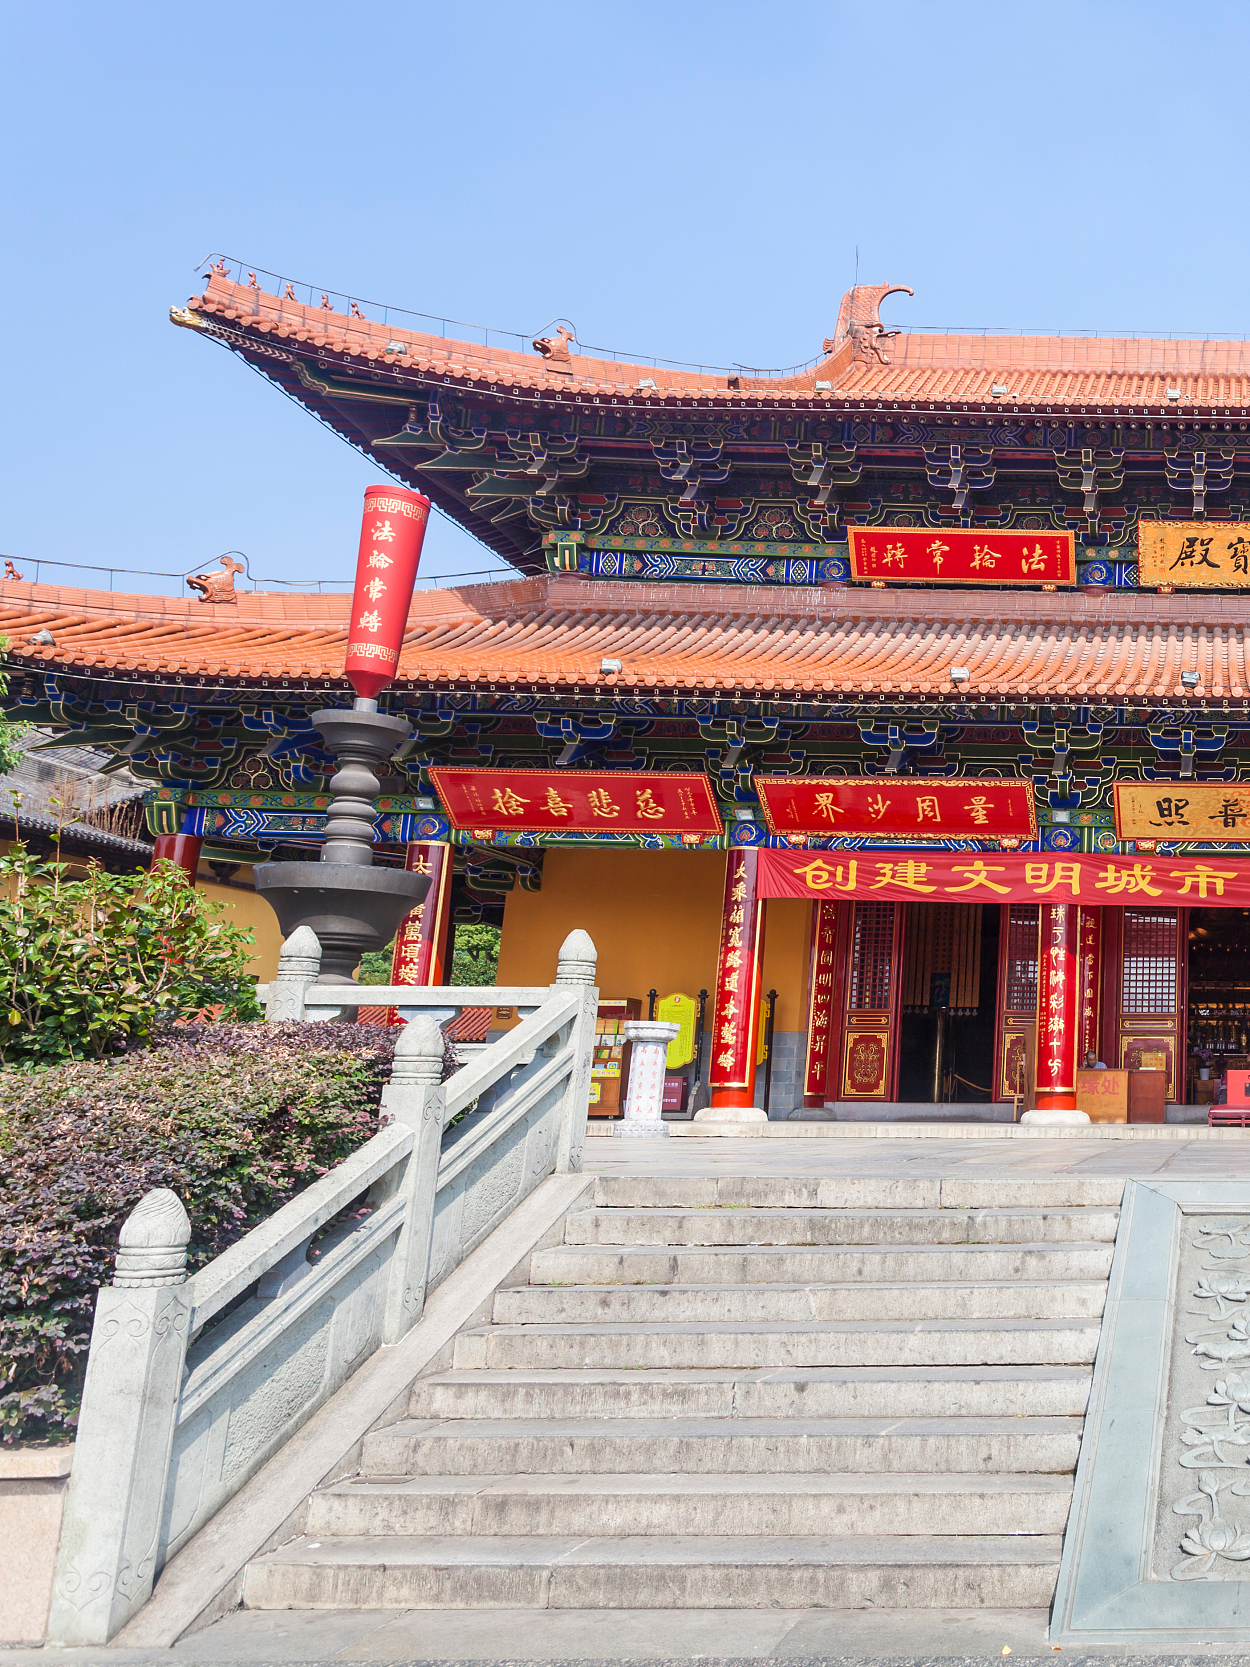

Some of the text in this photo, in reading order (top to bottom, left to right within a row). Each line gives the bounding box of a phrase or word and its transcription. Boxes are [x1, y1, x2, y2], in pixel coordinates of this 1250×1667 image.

[882, 540, 1049, 575] 法輪常轉
[357, 520, 397, 633] 法輪常轉
[490, 786, 666, 820] 慈悲喜捨
[812, 792, 995, 825] 量周沙界
[794, 858, 1239, 899] 创建文明城市
[1076, 1076, 1120, 1096] 缘处
